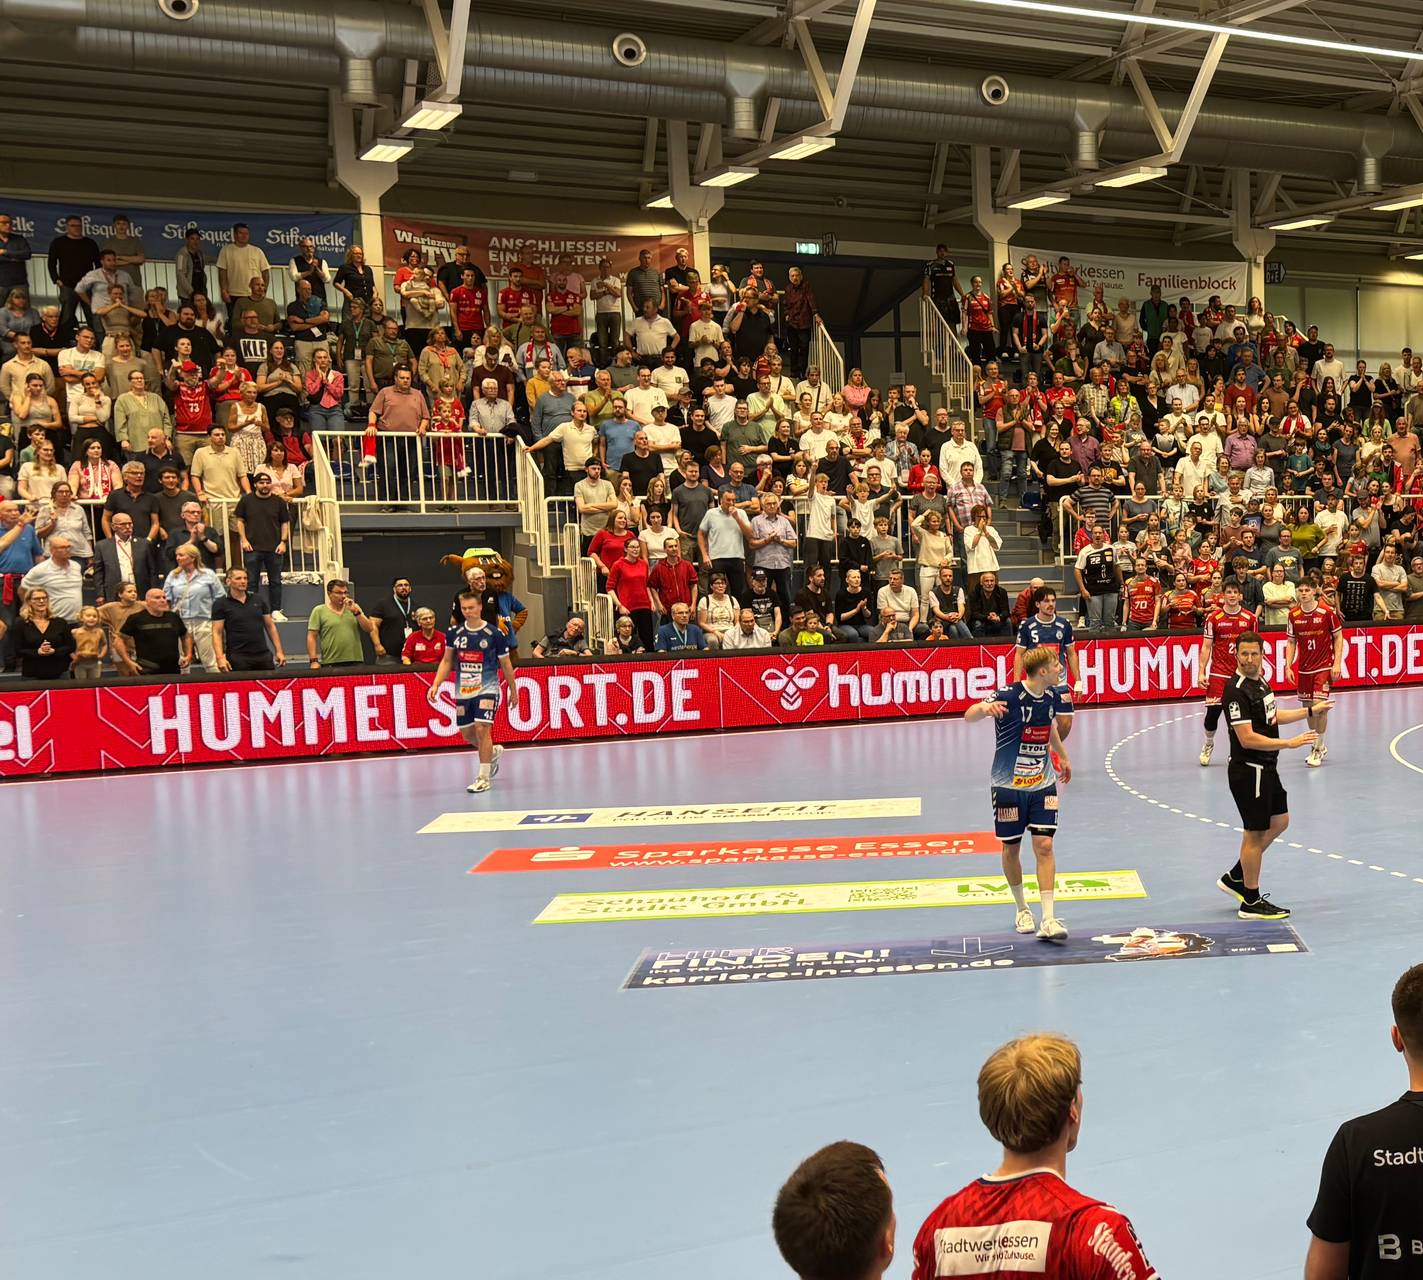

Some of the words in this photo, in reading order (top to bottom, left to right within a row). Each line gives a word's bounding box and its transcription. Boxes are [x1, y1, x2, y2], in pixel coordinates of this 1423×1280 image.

[1137, 272, 1237, 291] Familienblock
[1134, 601, 1147, 610] 70
[454, 637, 468, 649] 42
[1031, 630, 1039, 643] 5
[1307, 640, 1316, 651] 21
[828, 655, 1007, 708] hummel
[148, 669, 700, 755] HUMMELSORT.DE
[1020, 705, 1032, 723] 17
[609, 846, 975, 866] www.sparkasse-essen.de
[614, 842, 839, 861] Sparkasse
[854, 839, 975, 850] Essen
[652, 949, 890, 969] FINDEN!
[642, 957, 1015, 986] karriere-in-essen.de
[975, 1253, 989, 1263] Wir
